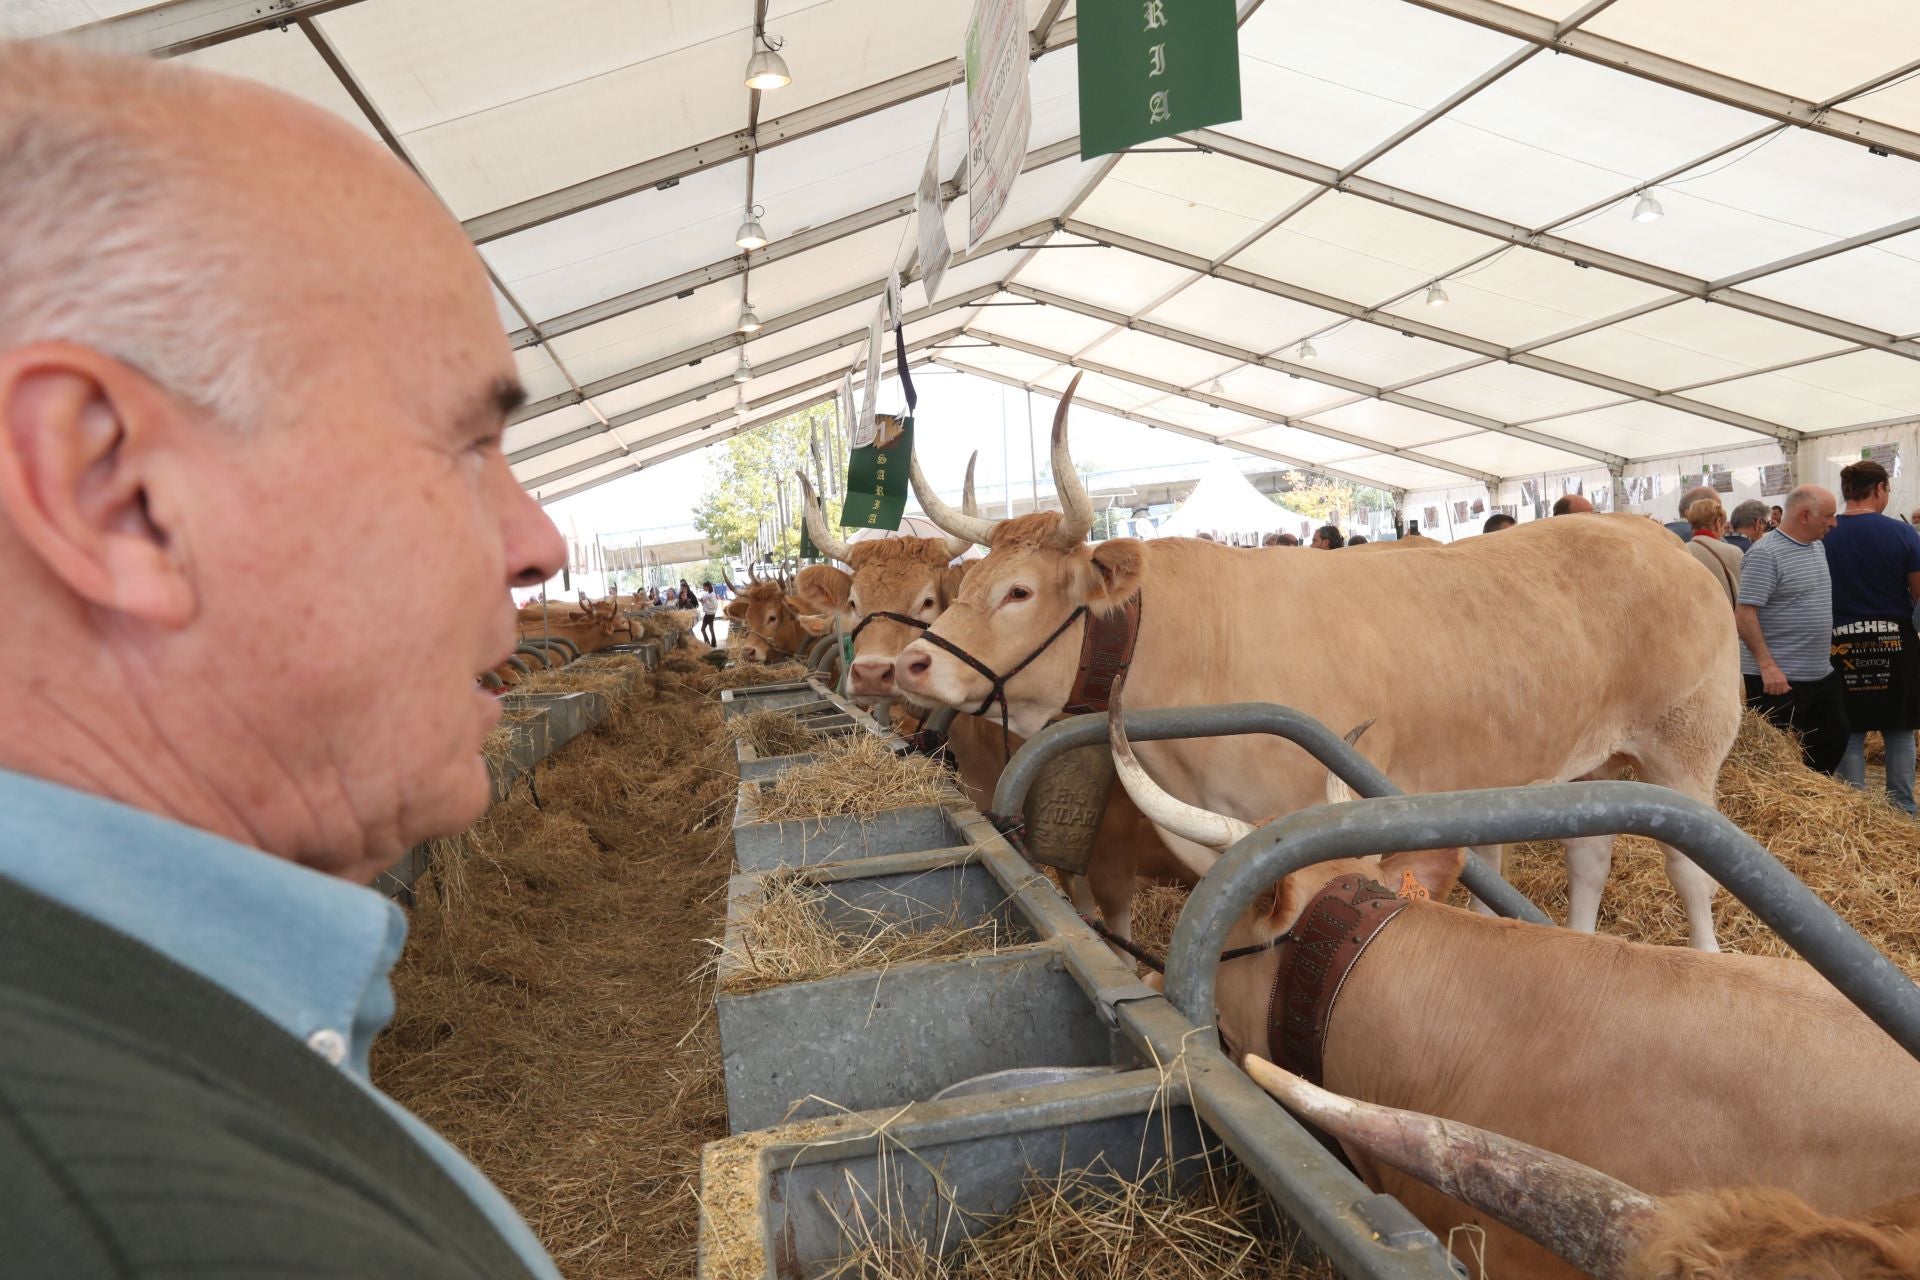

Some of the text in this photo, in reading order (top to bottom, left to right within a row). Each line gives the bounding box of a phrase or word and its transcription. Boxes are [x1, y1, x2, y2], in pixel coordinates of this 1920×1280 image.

[973, 139, 983, 168] 95
[868, 454, 887, 524] SARIA
[1856, 659, 1890, 667] EDITION
